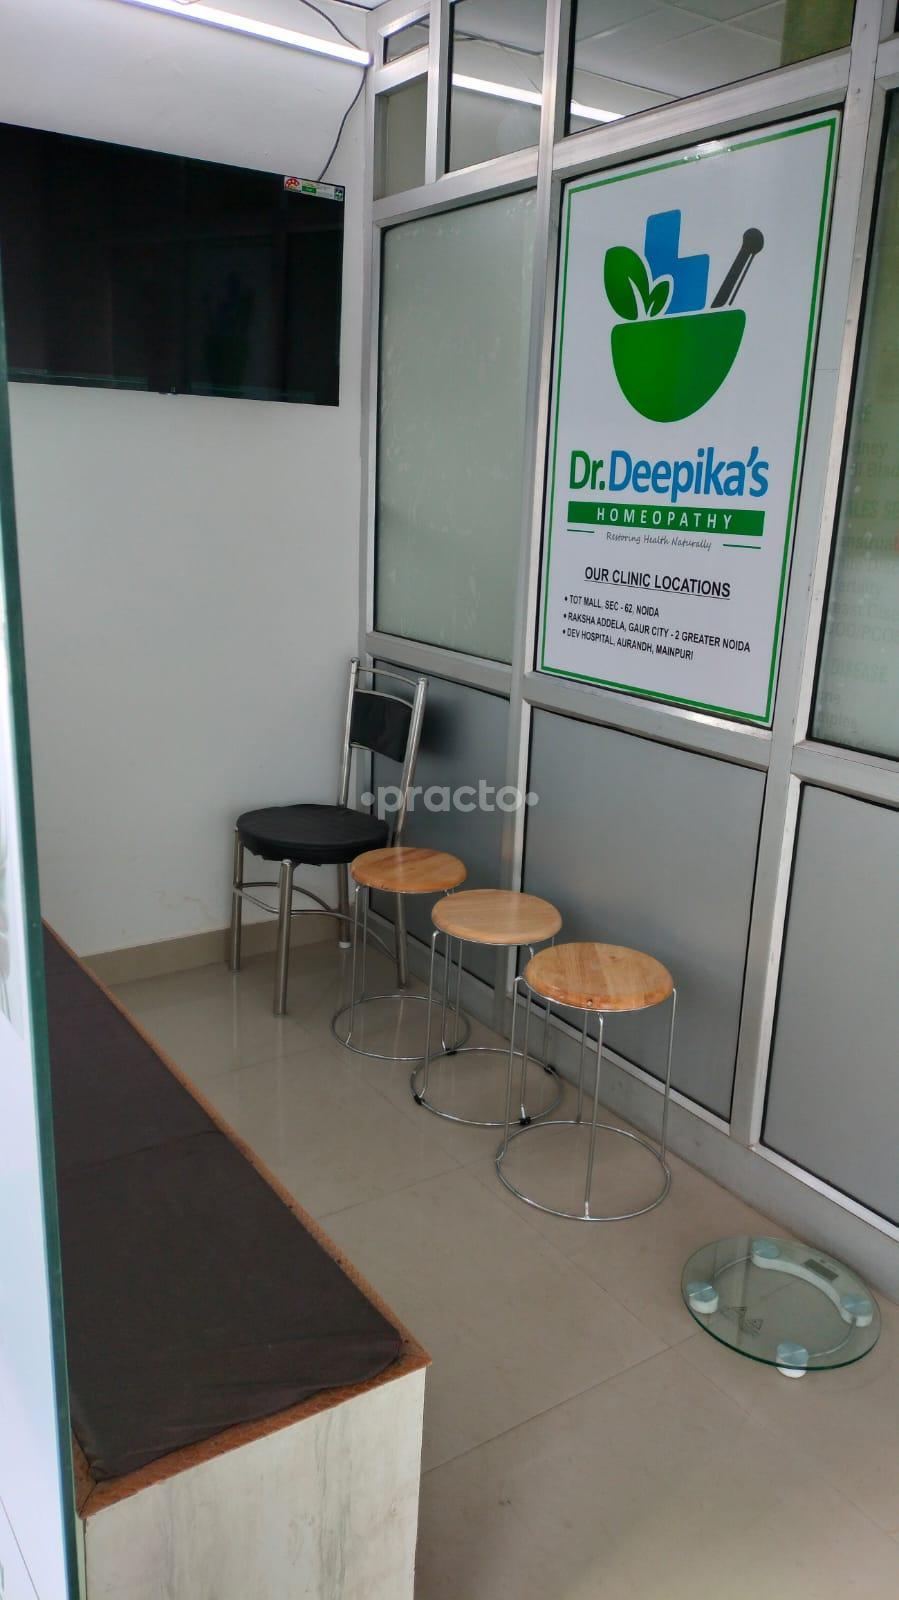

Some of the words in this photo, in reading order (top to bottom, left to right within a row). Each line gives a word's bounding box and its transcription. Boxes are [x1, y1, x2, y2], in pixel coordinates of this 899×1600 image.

[597, 507, 732, 529] HOMEOPATHY
[606, 532, 641, 545] Restoring
[643, 535, 670, 545] Health
[671, 538, 712, 551] Naturally
[585, 566, 609, 582] OUR
[612, 569, 651, 587] CLINIC
[654, 575, 731, 597] LOCATIONS
[569, 594, 582, 605] TOT
[605, 600, 619, 611] SEC
[636, 605, 659, 617] NOIDA
[567, 628, 580, 638] DEV
[581, 630, 616, 646] HOSPITAL,
[617, 637, 654, 654] AURANDH,
[655, 644, 694, 660] MAINPURI
[568, 612, 596, 625] RAKSHA
[597, 617, 627, 632] ADDELA,
[628, 622, 650, 635] GAUR
[651, 626, 669, 638] CITY
[675, 630, 680, 640] 2
[681, 631, 721, 647] GREATER
[722, 638, 751, 652] NOIDA
